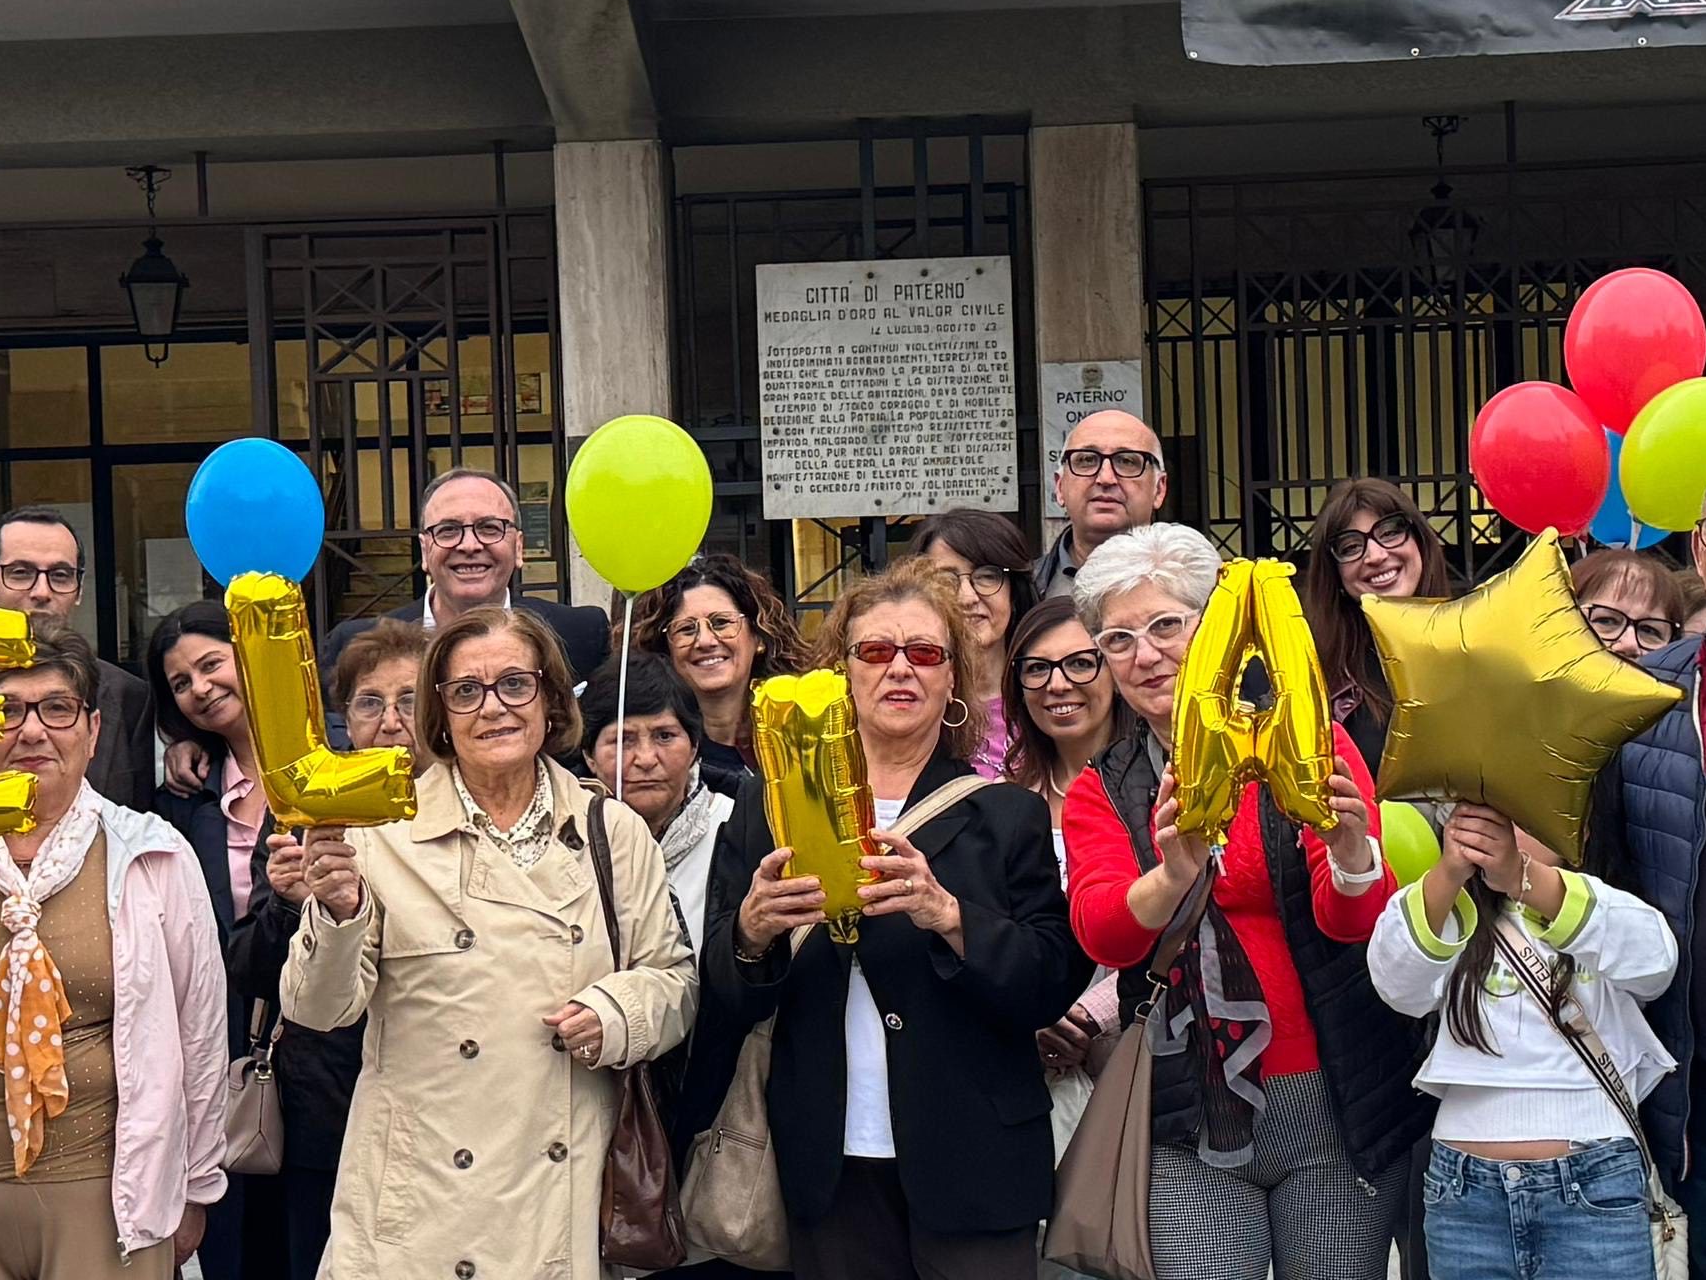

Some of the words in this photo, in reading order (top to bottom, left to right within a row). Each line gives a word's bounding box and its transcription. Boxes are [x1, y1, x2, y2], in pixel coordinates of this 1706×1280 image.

[865, 285, 877, 302] DI
[765, 309, 830, 324] MEDAGLIA
[838, 307, 876, 321] D'ORO
[884, 306, 901, 319] AL
[909, 304, 952, 318] VALOR
[961, 301, 1005, 316] CIVILE
[936, 322, 976, 333] AGOSTO
[767, 344, 831, 357] SOTTOPOSTA
[839, 345, 845, 354] A
[905, 339, 979, 351] VIOLENTISSIMI
[985, 339, 997, 348] ED
[766, 357, 842, 369] INDISCRIMINATI
[933, 351, 988, 362] TERRESTRI
[994, 350, 1007, 360] ED
[799, 369, 818, 379] CHE
[825, 366, 885, 378] CAUSAVANO
[892, 365, 904, 375] LA
[912, 363, 954, 375] PERDITA
[961, 362, 970, 372] DI
[977, 361, 1009, 372] OLTRE
[766, 380, 834, 392] QUATTROMILA
[841, 377, 888, 389] CITTADINI
[895, 377, 901, 387] E
[908, 376, 921, 386] LA
[927, 373, 992, 385] DISTRUZIONE
[999, 372, 1008, 382] DI
[763, 393, 789, 404] GRAN
[794, 391, 826, 403] PARTE
[831, 390, 864, 401] DELLE
[931, 386, 957, 397] DAVA
[962, 383, 1013, 395] COSTANTE
[1057, 390, 1127, 404] PATERNO'
[775, 403, 816, 415] ESEMPIO
[823, 402, 832, 413] DI
[839, 400, 874, 412] STOICO
[880, 398, 930, 410] CORAGGIO
[936, 397, 943, 408] E
[949, 397, 959, 407] DI
[965, 395, 1001, 407] NOBILE
[764, 414, 815, 427] DEDIZIONE
[820, 413, 845, 424] ALLA
[909, 407, 977, 421] POPOLAZIONE
[982, 405, 1014, 418] TUTTA
[785, 427, 804, 437] CON
[811, 424, 865, 436] FIERISSIMO
[871, 422, 923, 434] CONTEGNO
[930, 419, 992, 431] RESISTETTE
[814, 435, 868, 448] MALGRADO
[874, 434, 887, 445] LE
[917, 431, 942, 443] DURE
[950, 428, 1014, 442] SOFFERENZE
[827, 447, 847, 459] PUR
[853, 445, 882, 457] NEGLI
[889, 444, 925, 456] ORRORI
[931, 443, 938, 454] E
[944, 442, 960, 454] NEI
[966, 440, 1011, 453] DISASTRI
[766, 470, 850, 484] MANIFESTAZIONE
[857, 469, 865, 480] DI
[873, 467, 918, 480] ELEVATE
[961, 464, 999, 476] CIVICHE
[1007, 463, 1013, 474] E
[795, 460, 827, 471] DELLA
[882, 457, 895, 468] LA
[794, 484, 803, 495] DI
[810, 481, 860, 494] GENEROSO
[865, 480, 901, 492] SPIRITO
[905, 479, 914, 490] DI
[1519, 946, 1551, 982] ELLIS
[1598, 1052, 1624, 1093] ELLIS
